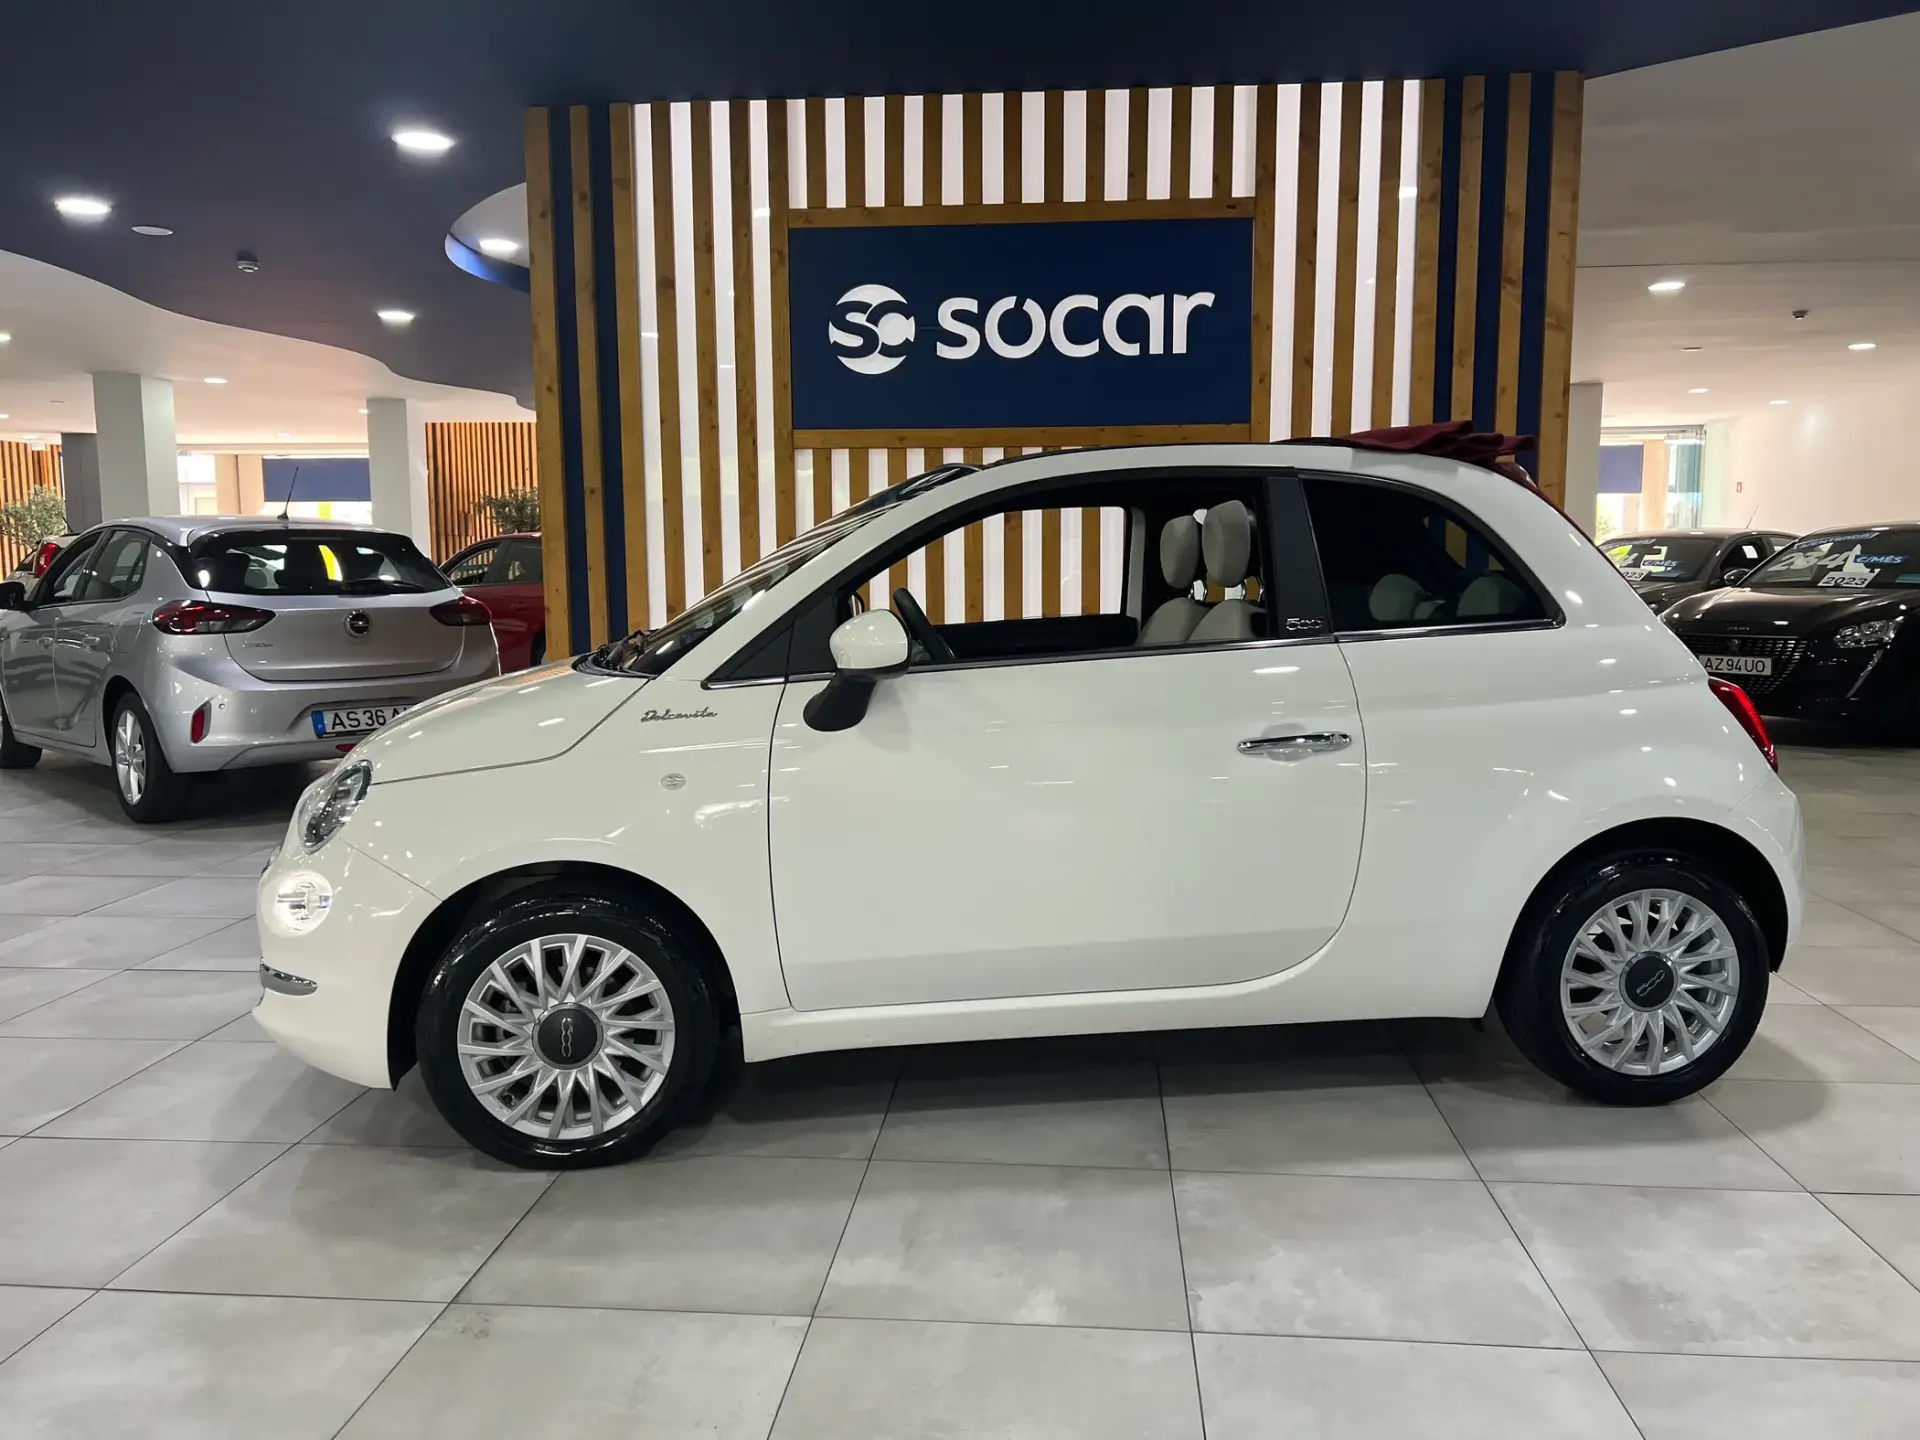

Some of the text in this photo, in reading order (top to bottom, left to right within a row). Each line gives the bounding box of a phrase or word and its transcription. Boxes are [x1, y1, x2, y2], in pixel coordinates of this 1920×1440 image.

[1856, 554, 1903, 564] C/MÊS
[1622, 571, 1644, 579] 023
[1822, 576, 1868, 586] 2023
[1726, 658, 1742, 672] 94
[331, 710, 361, 731] AS
[362, 709, 387, 727] 36
